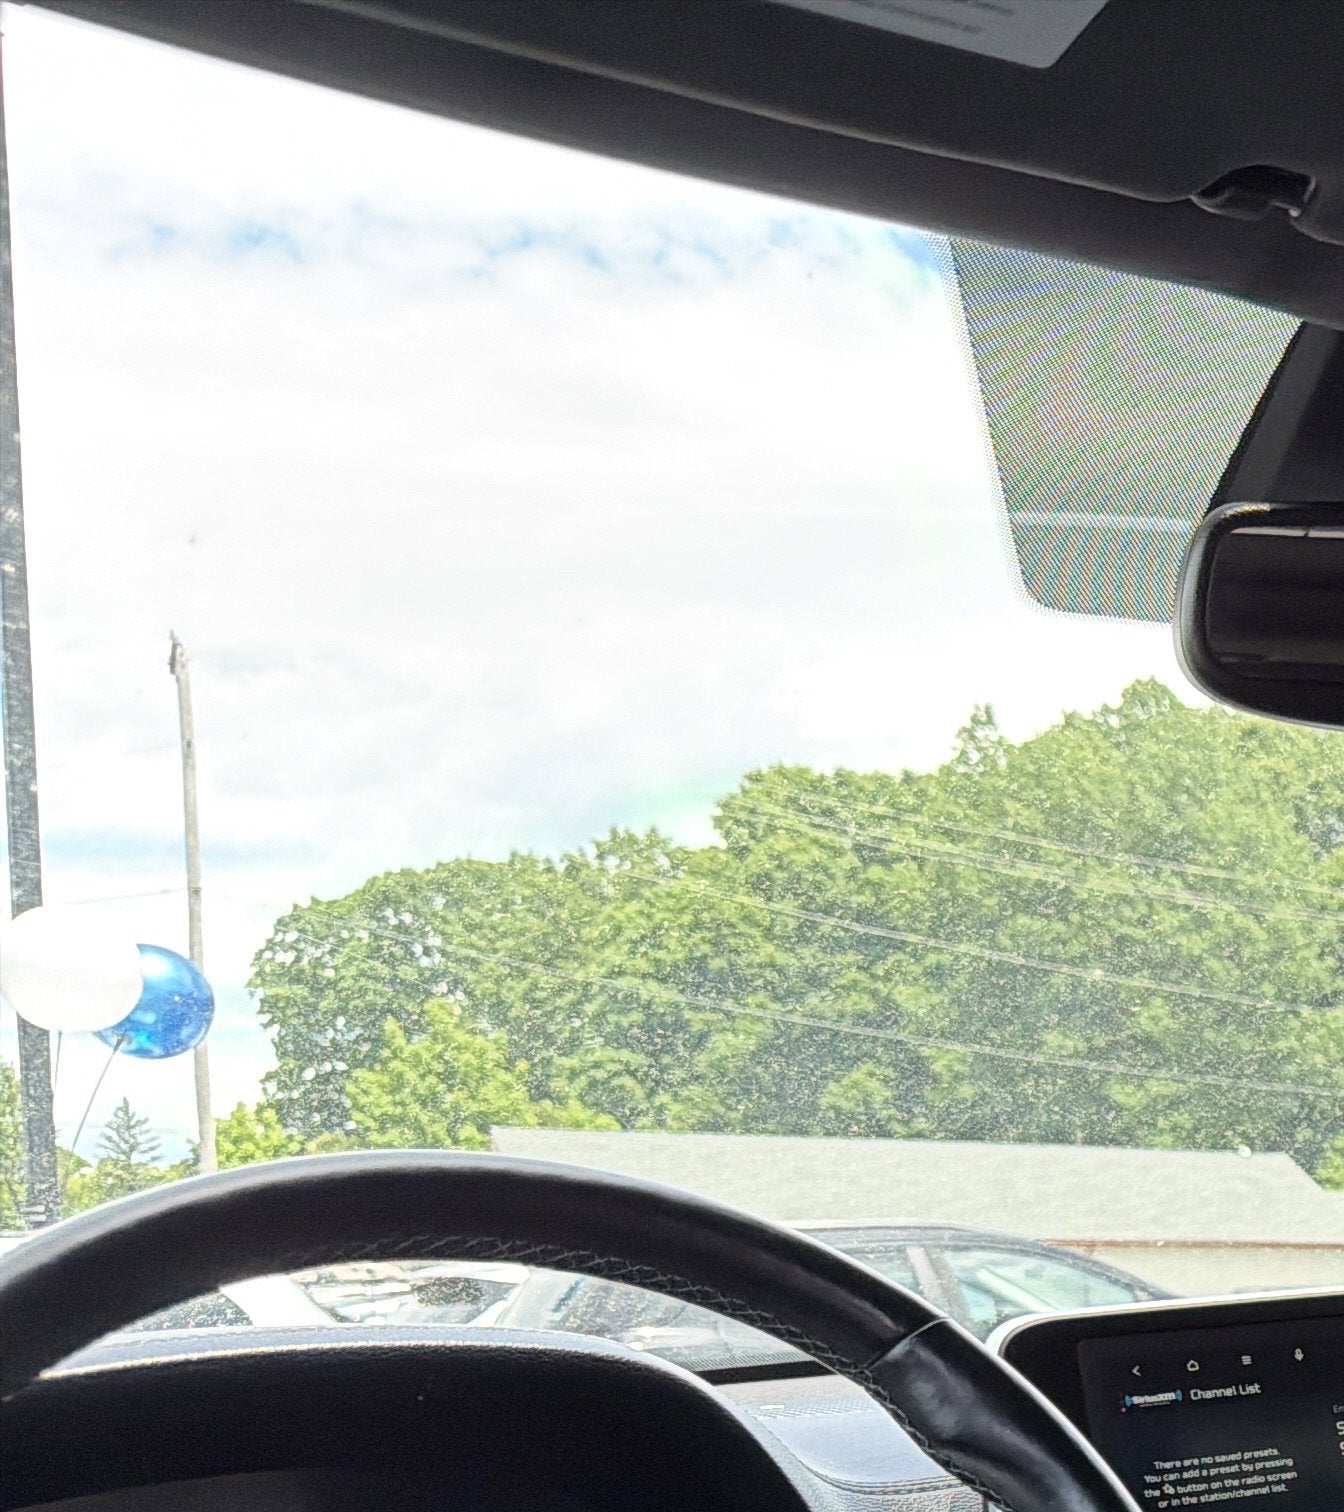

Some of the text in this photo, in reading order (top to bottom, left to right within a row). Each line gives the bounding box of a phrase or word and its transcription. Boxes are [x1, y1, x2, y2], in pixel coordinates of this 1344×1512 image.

[1190, 1383, 1262, 1401] Channel List
[1144, 1474, 1162, 1484] You
[1163, 1473, 1181, 1482] can
[1182, 1469, 1201, 1479] add
[1209, 1464, 1240, 1478] preset
[1241, 1463, 1254, 1472] by
[1255, 1457, 1294, 1471] pressing
[1153, 1461, 1182, 1470] There
[1182, 1458, 1200, 1466] are
[1201, 1456, 1214, 1464] no
[1215, 1452, 1242, 1463] saved
[1144, 1470, 1298, 1498] the button on the radio screen
[1158, 1499, 1169, 1508] or
[1171, 1498, 1181, 1506] in
[1181, 1494, 1199, 1504] the
[1199, 1486, 1271, 1503] station/channel
